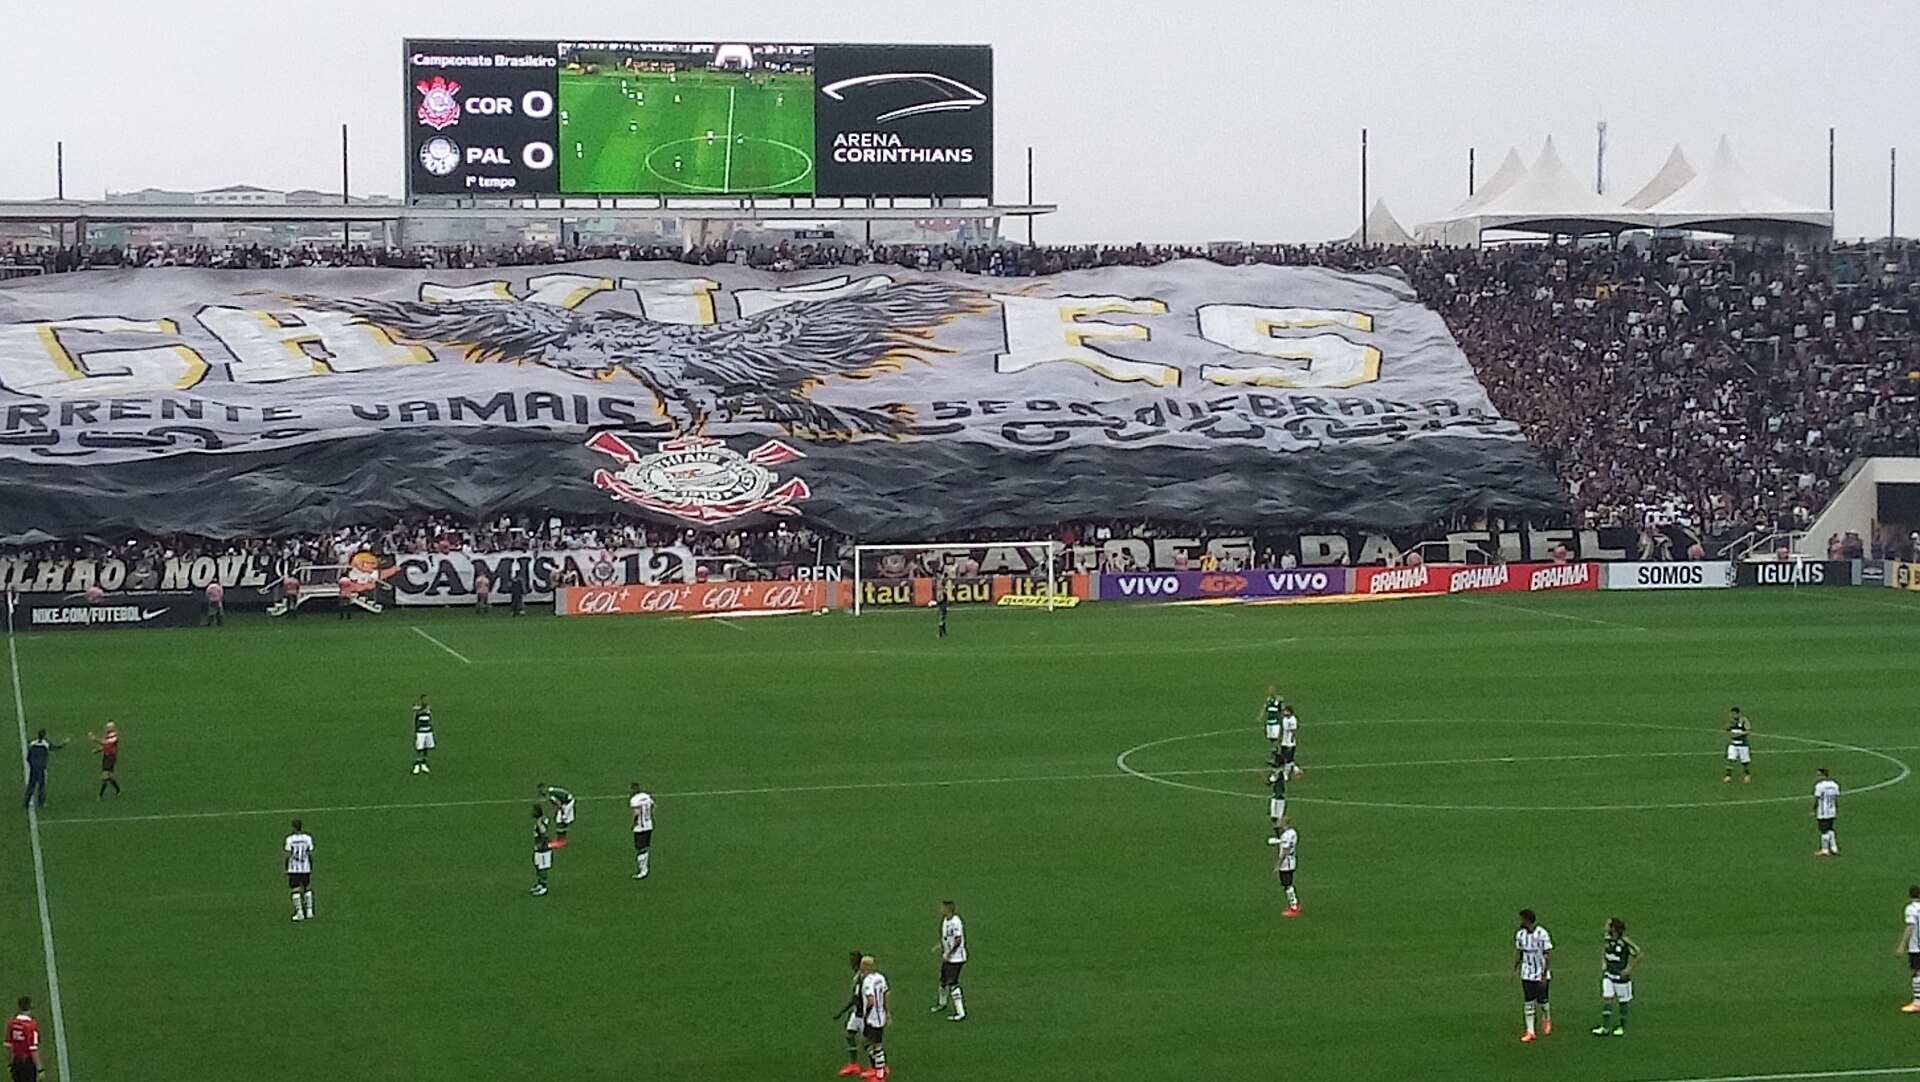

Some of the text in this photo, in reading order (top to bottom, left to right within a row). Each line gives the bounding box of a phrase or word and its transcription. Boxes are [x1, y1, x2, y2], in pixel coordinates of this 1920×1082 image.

[413, 53, 557, 68] Campeonato Brasileiro
[465, 90, 553, 118] COR 0
[833, 133, 901, 147] ARENA
[466, 141, 554, 169] PAL 0
[833, 148, 973, 163] CORINTHIANS
[478, 176, 516, 189] tempo
[350, 391, 637, 433] JAMAIS
[1301, 533, 1400, 567] DA
[619, 552, 684, 586] 12
[1370, 567, 1429, 594] BRAHMA
[1450, 565, 1509, 592] BRAHMA
[1530, 563, 1589, 591] BRAHMA
[1637, 565, 1703, 585] SOMOS
[1757, 563, 1825, 584] IGUAIS
[944, 578, 991, 602] taú
